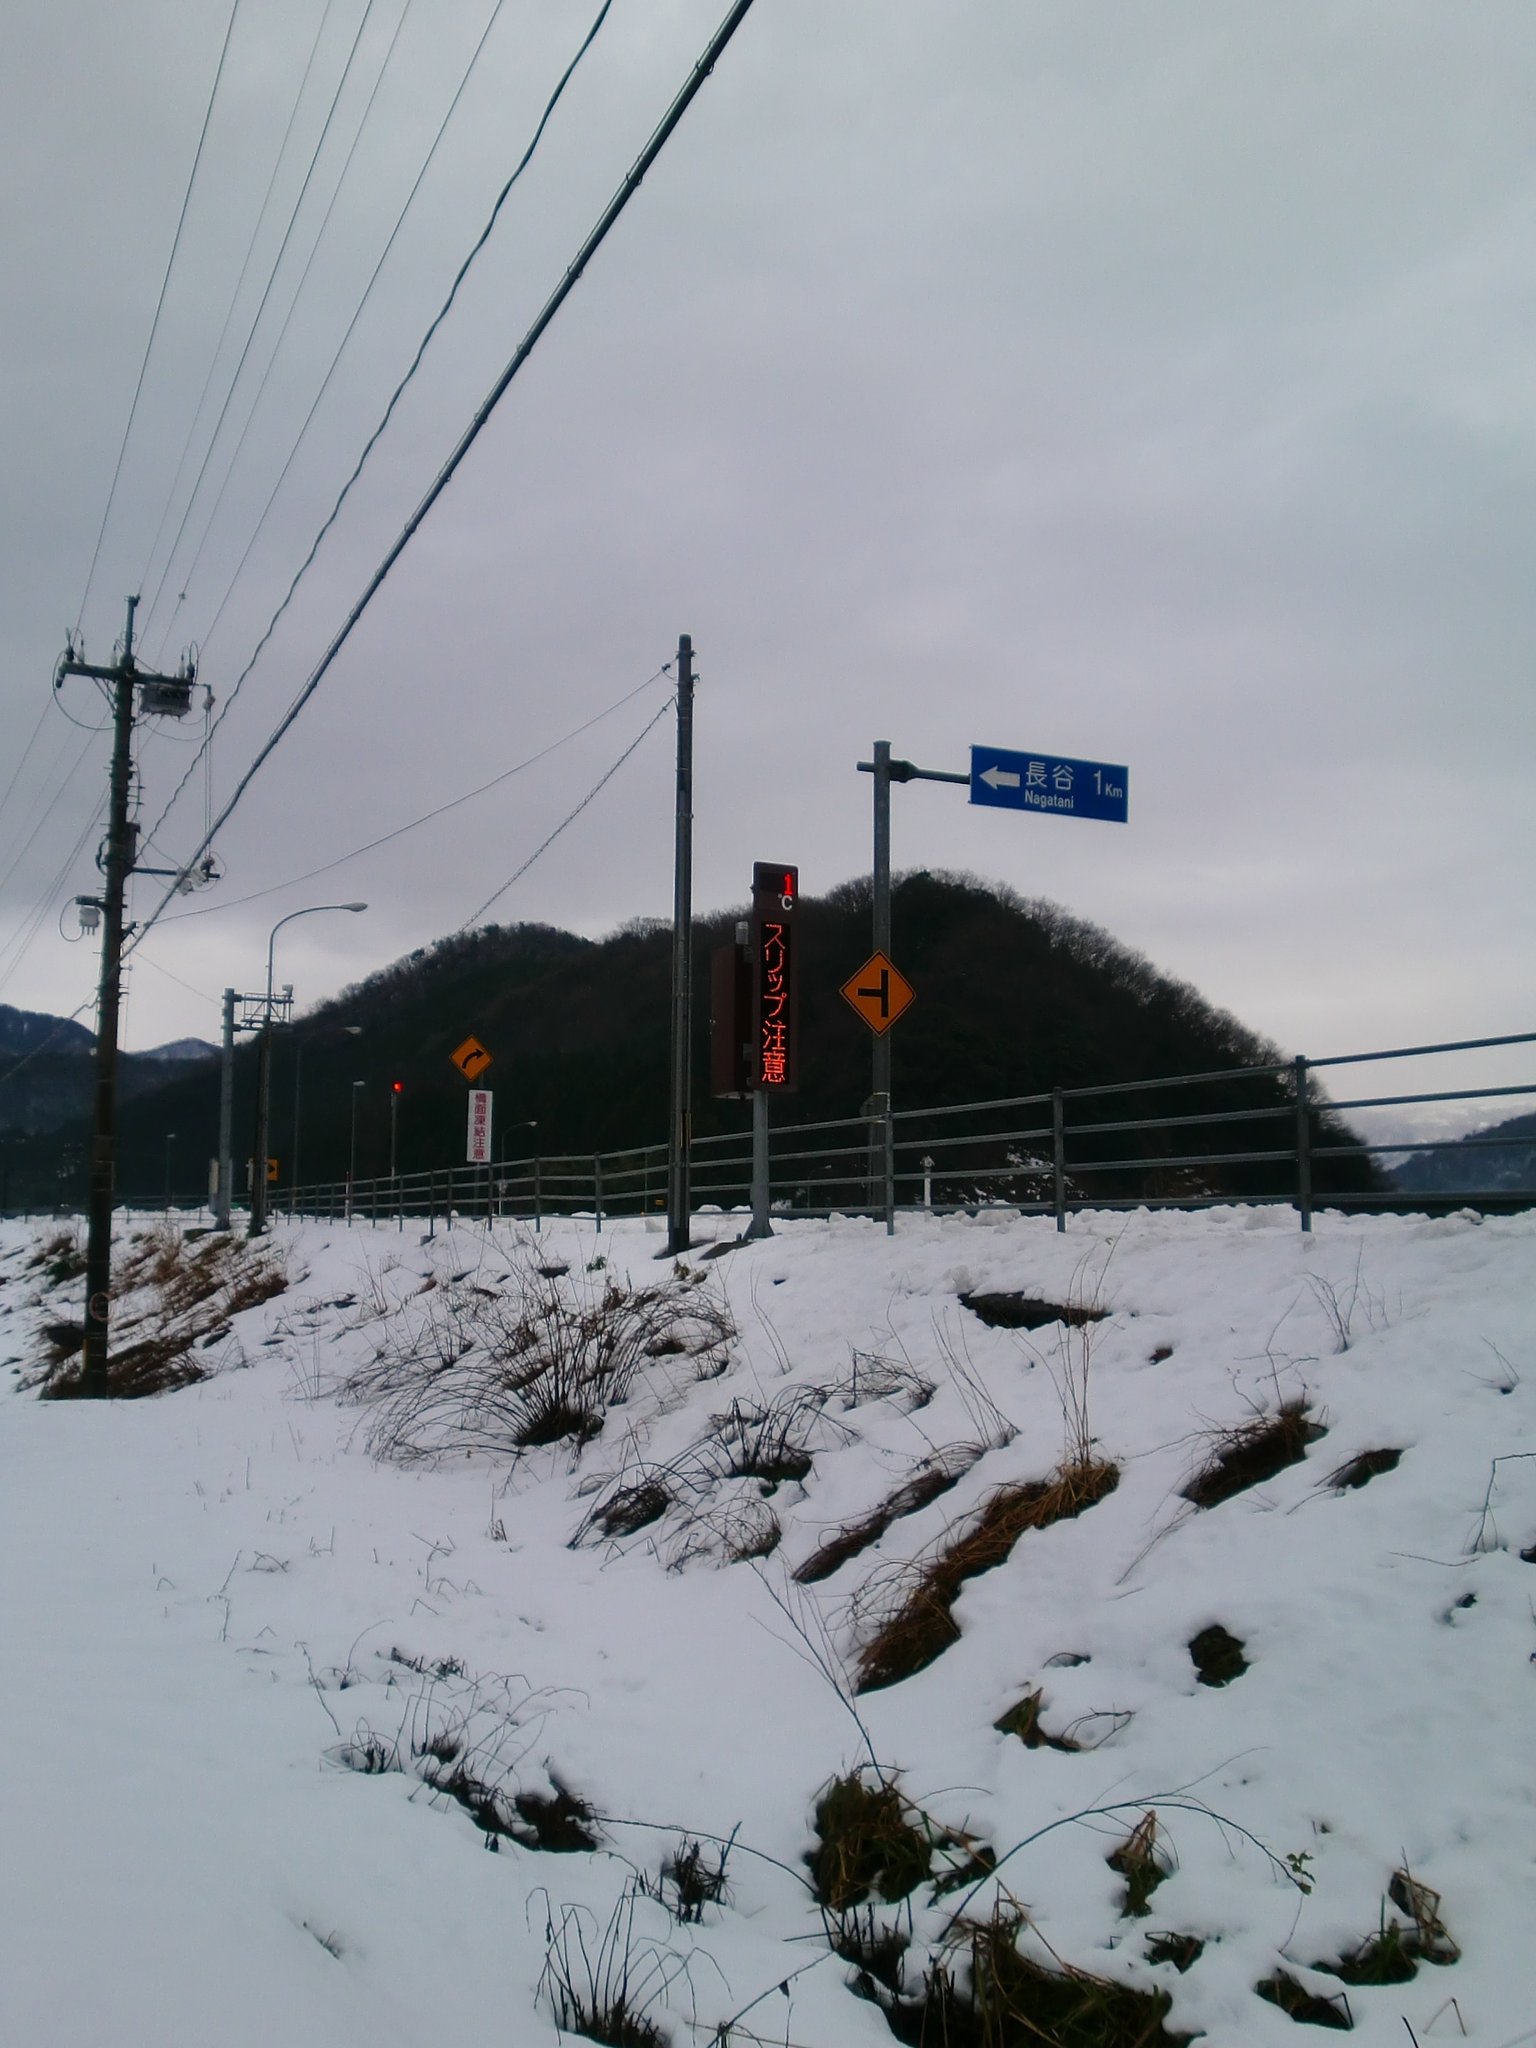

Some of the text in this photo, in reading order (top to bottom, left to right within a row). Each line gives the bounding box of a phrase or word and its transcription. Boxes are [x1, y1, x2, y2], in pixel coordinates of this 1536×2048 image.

[1026, 761, 1074, 790] 長谷
[1024, 789, 1074, 809] Nagatani
[784, 873, 793, 895] 1
[762, 923, 787, 1083] スリップ注意
